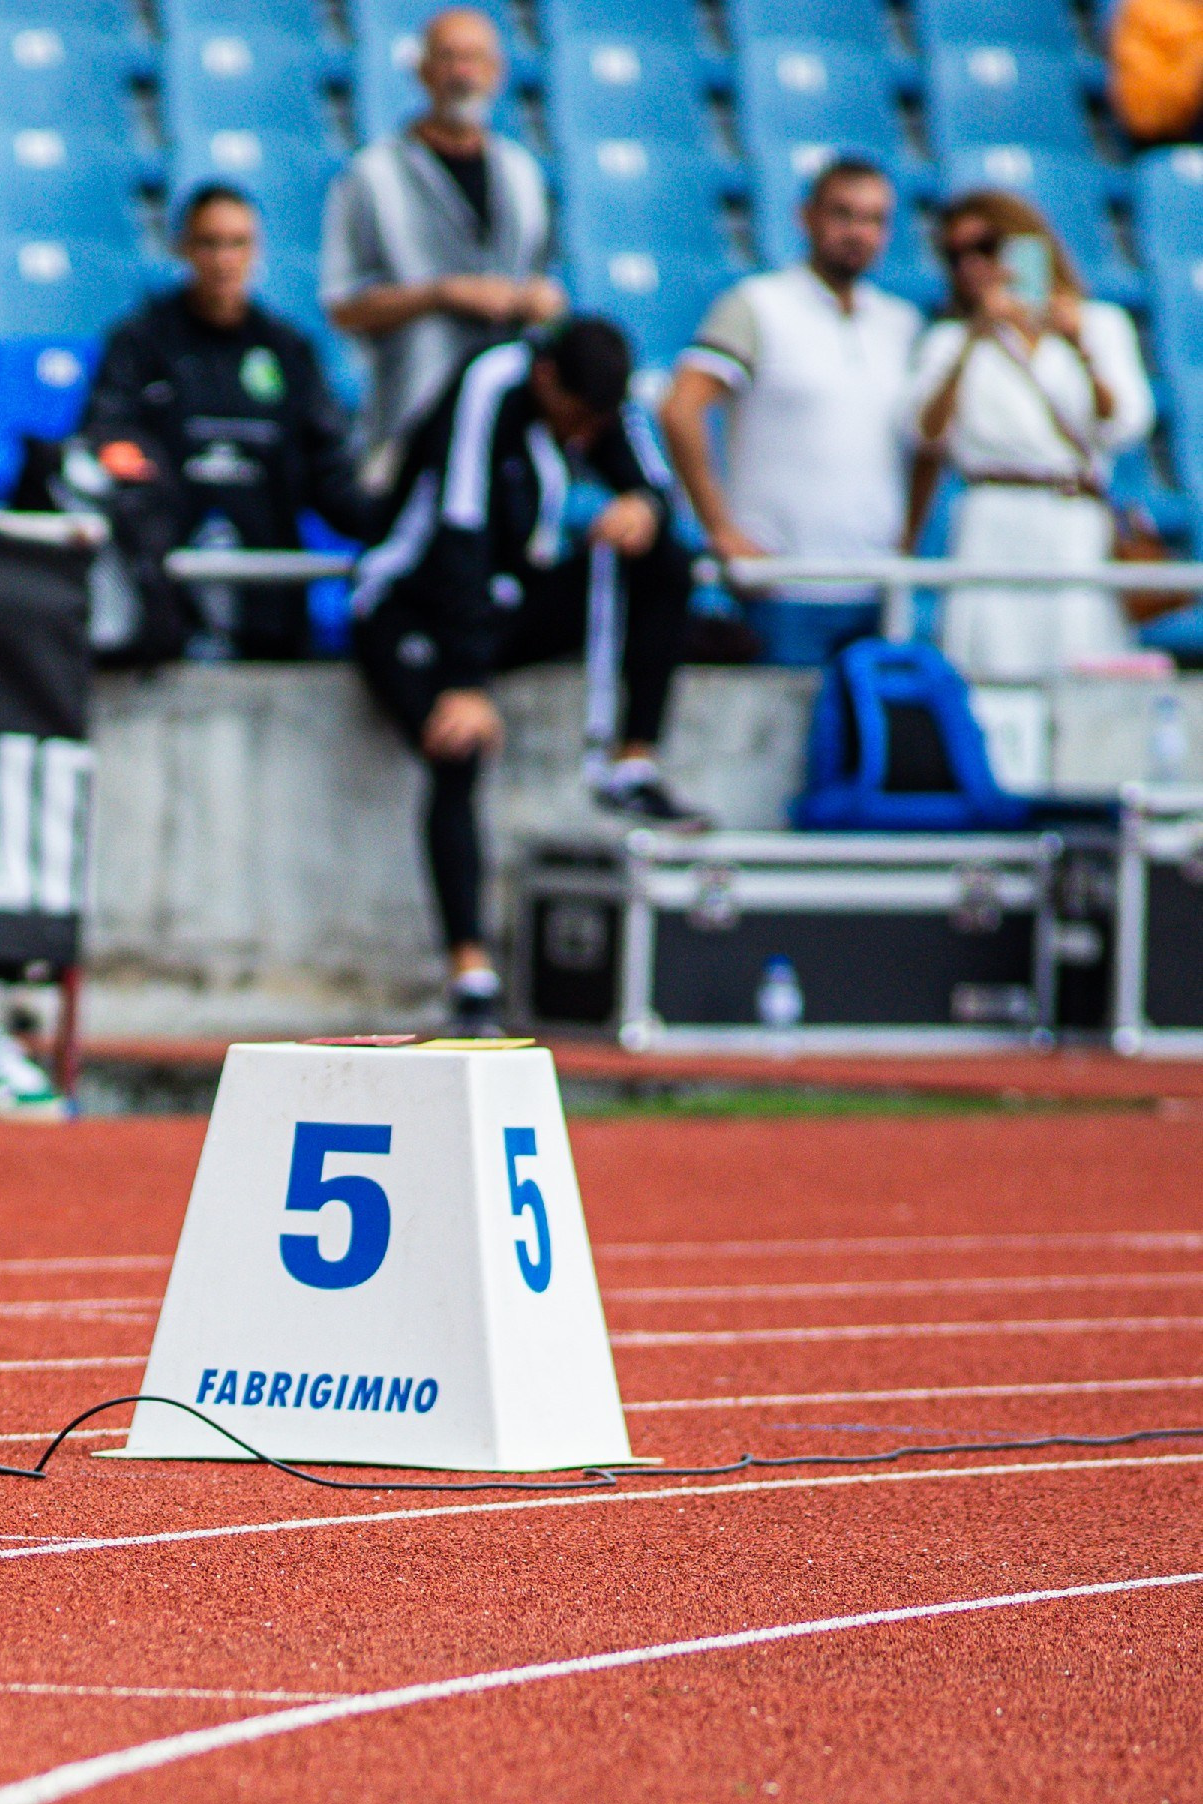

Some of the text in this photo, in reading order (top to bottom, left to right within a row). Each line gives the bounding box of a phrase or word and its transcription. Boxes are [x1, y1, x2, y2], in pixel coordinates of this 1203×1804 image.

[279, 1121, 392, 1290] 5
[503, 1126, 551, 1293] 5
[195, 1368, 439, 1415] FABRIGIMNO
